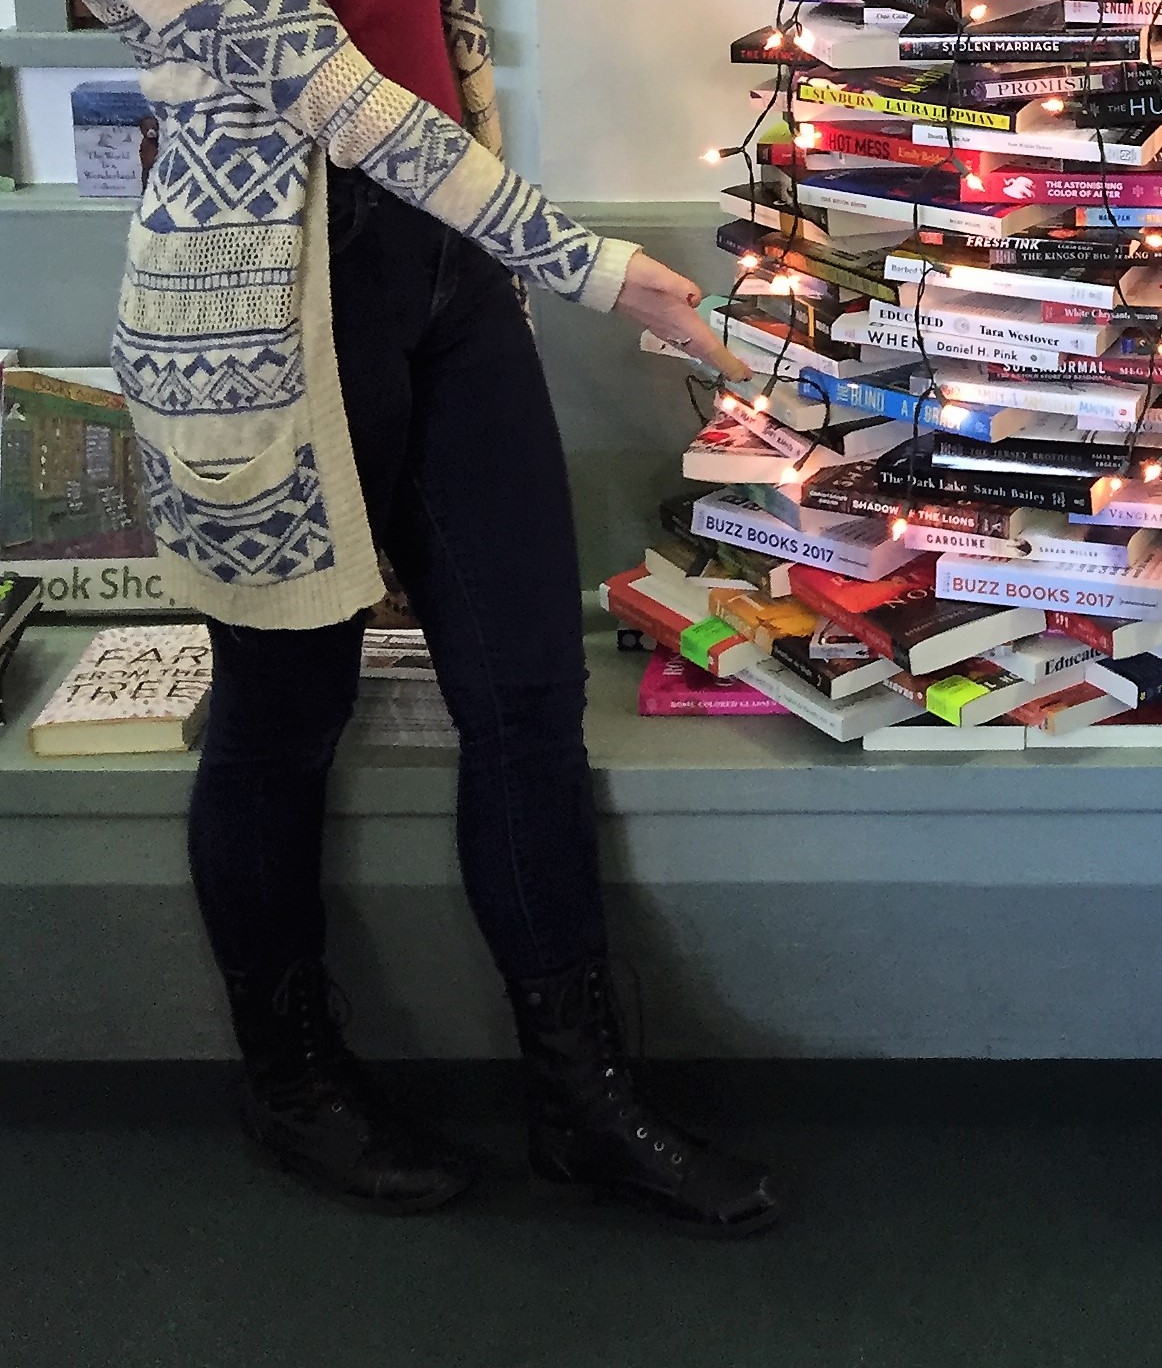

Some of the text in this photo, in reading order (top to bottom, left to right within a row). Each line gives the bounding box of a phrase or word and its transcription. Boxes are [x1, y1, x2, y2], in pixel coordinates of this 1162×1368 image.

[995, 41, 1060, 52] MARRIAGE
[886, 100, 929, 118] LAURA
[1108, 104, 1126, 113] THE
[830, 133, 890, 160] HOT MESS
[1046, 180, 1063, 189] THE
[1048, 189, 1089, 198] COLOR OF
[966, 235, 1041, 250] FRESH INK
[1022, 251, 1090, 261] THE KINGS OF
[1065, 307, 1089, 318] White
[980, 325, 1060, 347] Tara Westover
[936, 340, 974, 356] Daniel
[977, 345, 991, 357] H.
[994, 348, 1018, 362] Pink
[851, 387, 885, 413] BLIND
[880, 471, 904, 485] The
[939, 478, 968, 493] Lake
[974, 483, 1007, 498] Sarah
[1011, 487, 1046, 506] Bailey
[852, 499, 976, 528] SHADOW THE LIONS
[706, 515, 834, 563] BUZZ BOOKS 2017
[927, 534, 985, 549] CAROLINE
[952, 577, 1115, 608] BUZZ BOOKS 2017
[95, 646, 213, 668] FAR
[75, 668, 211, 683] FROM THE
[66, 680, 212, 703] TREE
